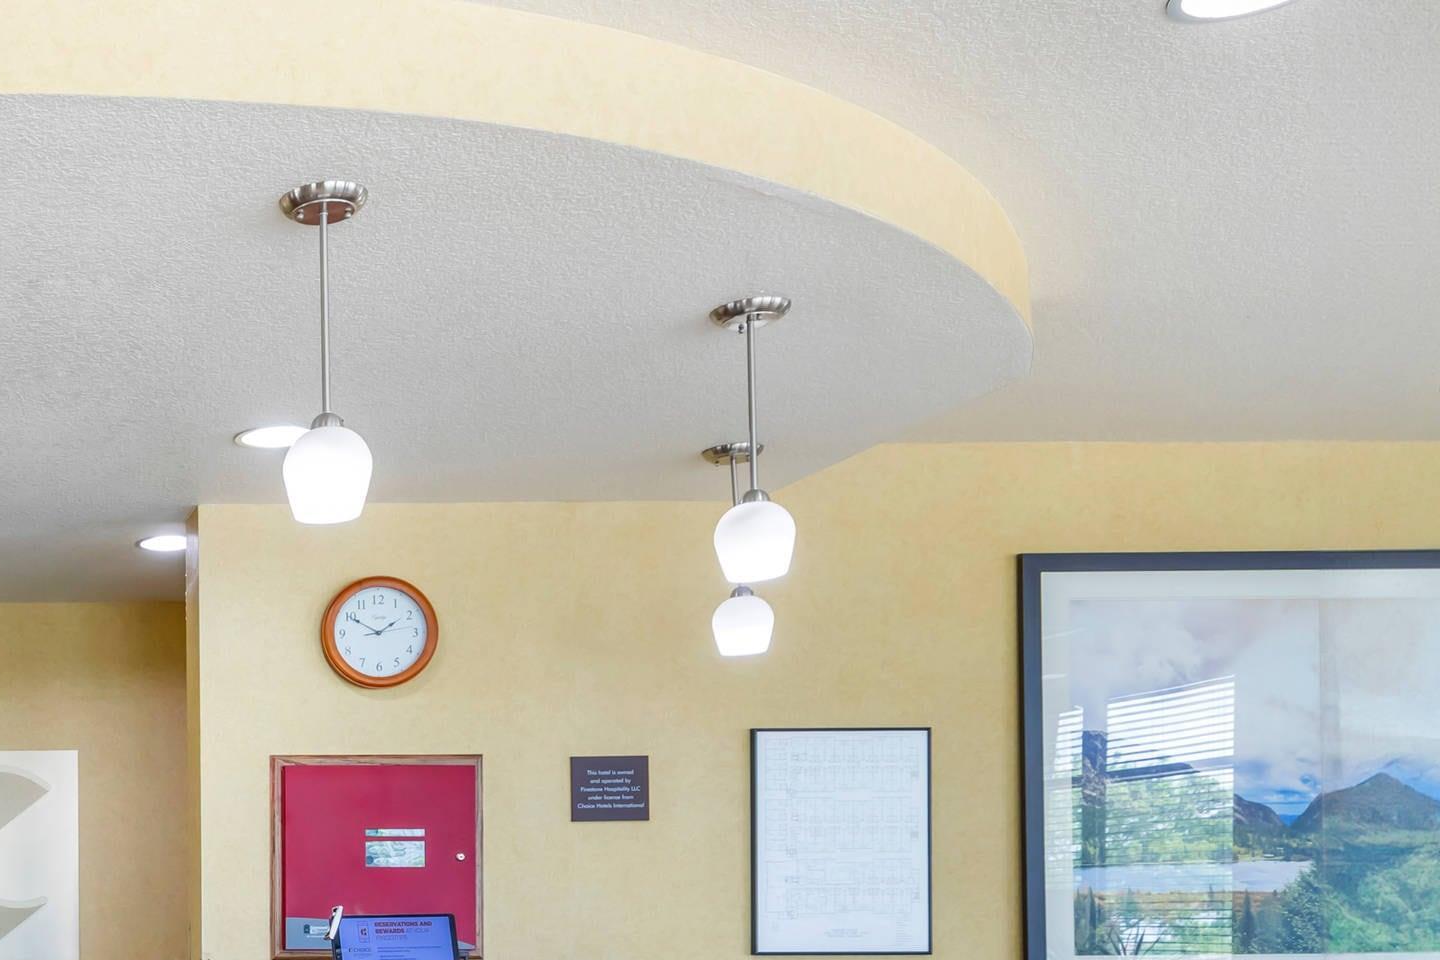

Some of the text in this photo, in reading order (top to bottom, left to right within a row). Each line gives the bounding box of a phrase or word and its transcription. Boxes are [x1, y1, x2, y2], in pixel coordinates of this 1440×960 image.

[357, 599, 366, 610] 11
[372, 594, 385, 605] 12
[394, 598, 398, 608] 1
[345, 611, 357, 622] 10
[406, 610, 413, 620] 2
[339, 629, 346, 639] 9
[412, 627, 419, 638] 3
[345, 647, 352, 656] 8
[406, 644, 413, 654] 4
[359, 657, 366, 668] 7
[376, 662, 383, 672] 6
[393, 657, 400, 668] 5
